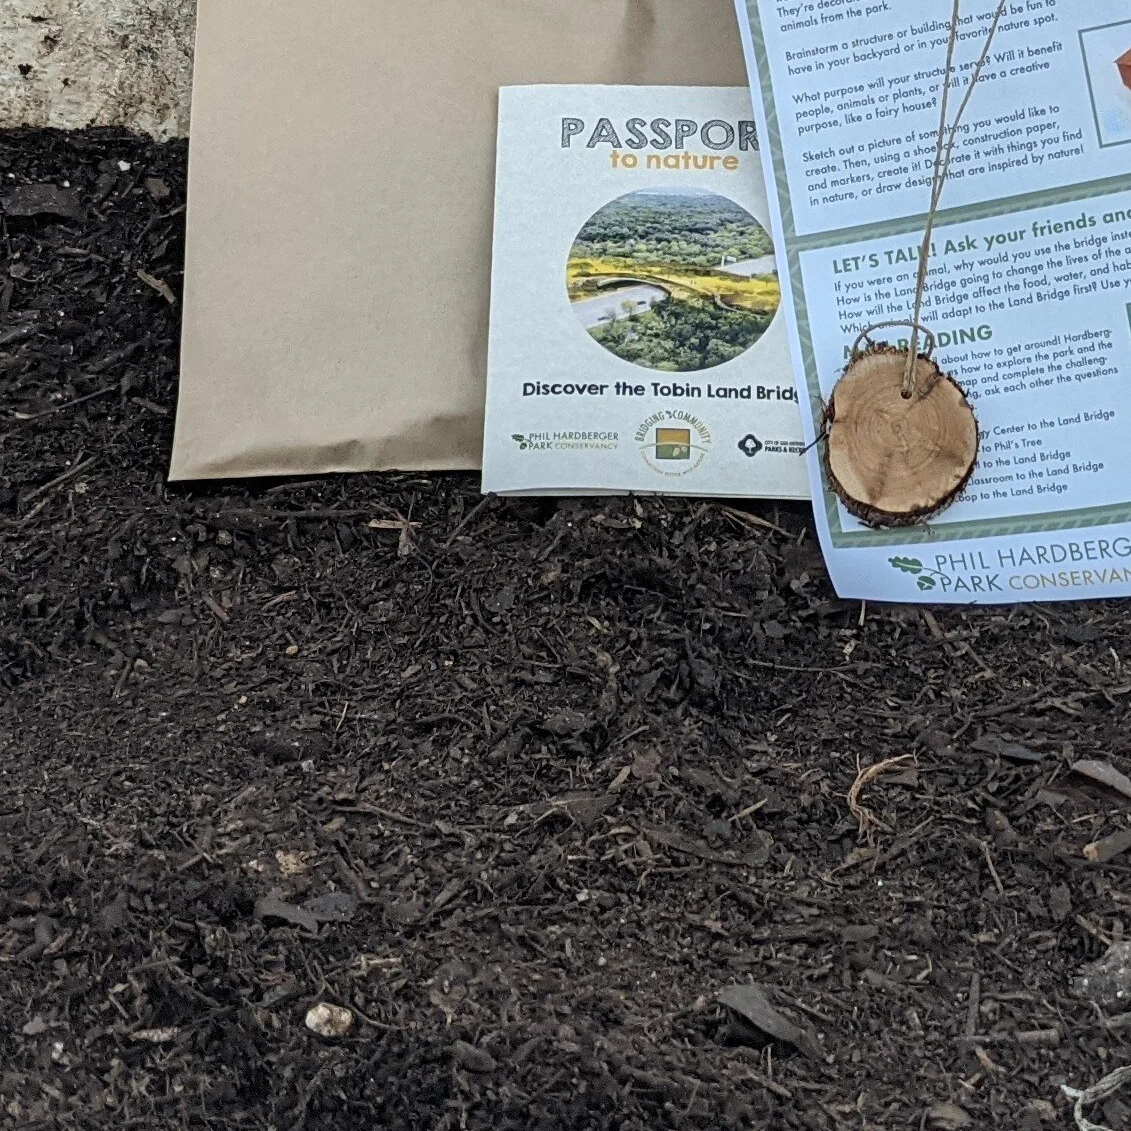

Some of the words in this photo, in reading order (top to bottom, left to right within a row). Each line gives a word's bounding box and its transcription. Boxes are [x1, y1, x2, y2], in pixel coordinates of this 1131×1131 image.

[780, 15, 818, 32] animals
[820, 12, 844, 23] from
[846, 7, 862, 18] the
[865, 0, 891, 17] park.
[797, 119, 842, 136] purpose,
[844, 112, 862, 124] like
[875, 106, 899, 118] fairy
[901, 96, 936, 113] house?
[560, 117, 759, 151] PASSPOR
[610, 152, 637, 169] to
[646, 154, 738, 170] nature
[832, 253, 879, 274] LET'S
[883, 239, 936, 264] TAL!
[944, 234, 978, 255] Ask
[983, 229, 1026, 248] your
[1031, 212, 1096, 237] friends
[522, 382, 609, 396] Discover
[615, 382, 645, 396] the
[651, 383, 701, 398] Tobin
[707, 384, 750, 399] Land
[553, 432, 618, 440] HARDBERGER
[635, 412, 665, 441] BRIDGING
[673, 410, 711, 444] COMMUNITY
[528, 441, 552, 449] PARK
[994, 440, 1019, 451] Phil's
[1020, 438, 1042, 447] Tree
[995, 457, 1010, 466] the
[1013, 452, 1036, 464] Land
[1039, 449, 1071, 461] Bridge
[935, 551, 990, 574] PHIL
[940, 573, 1003, 592] PARK
